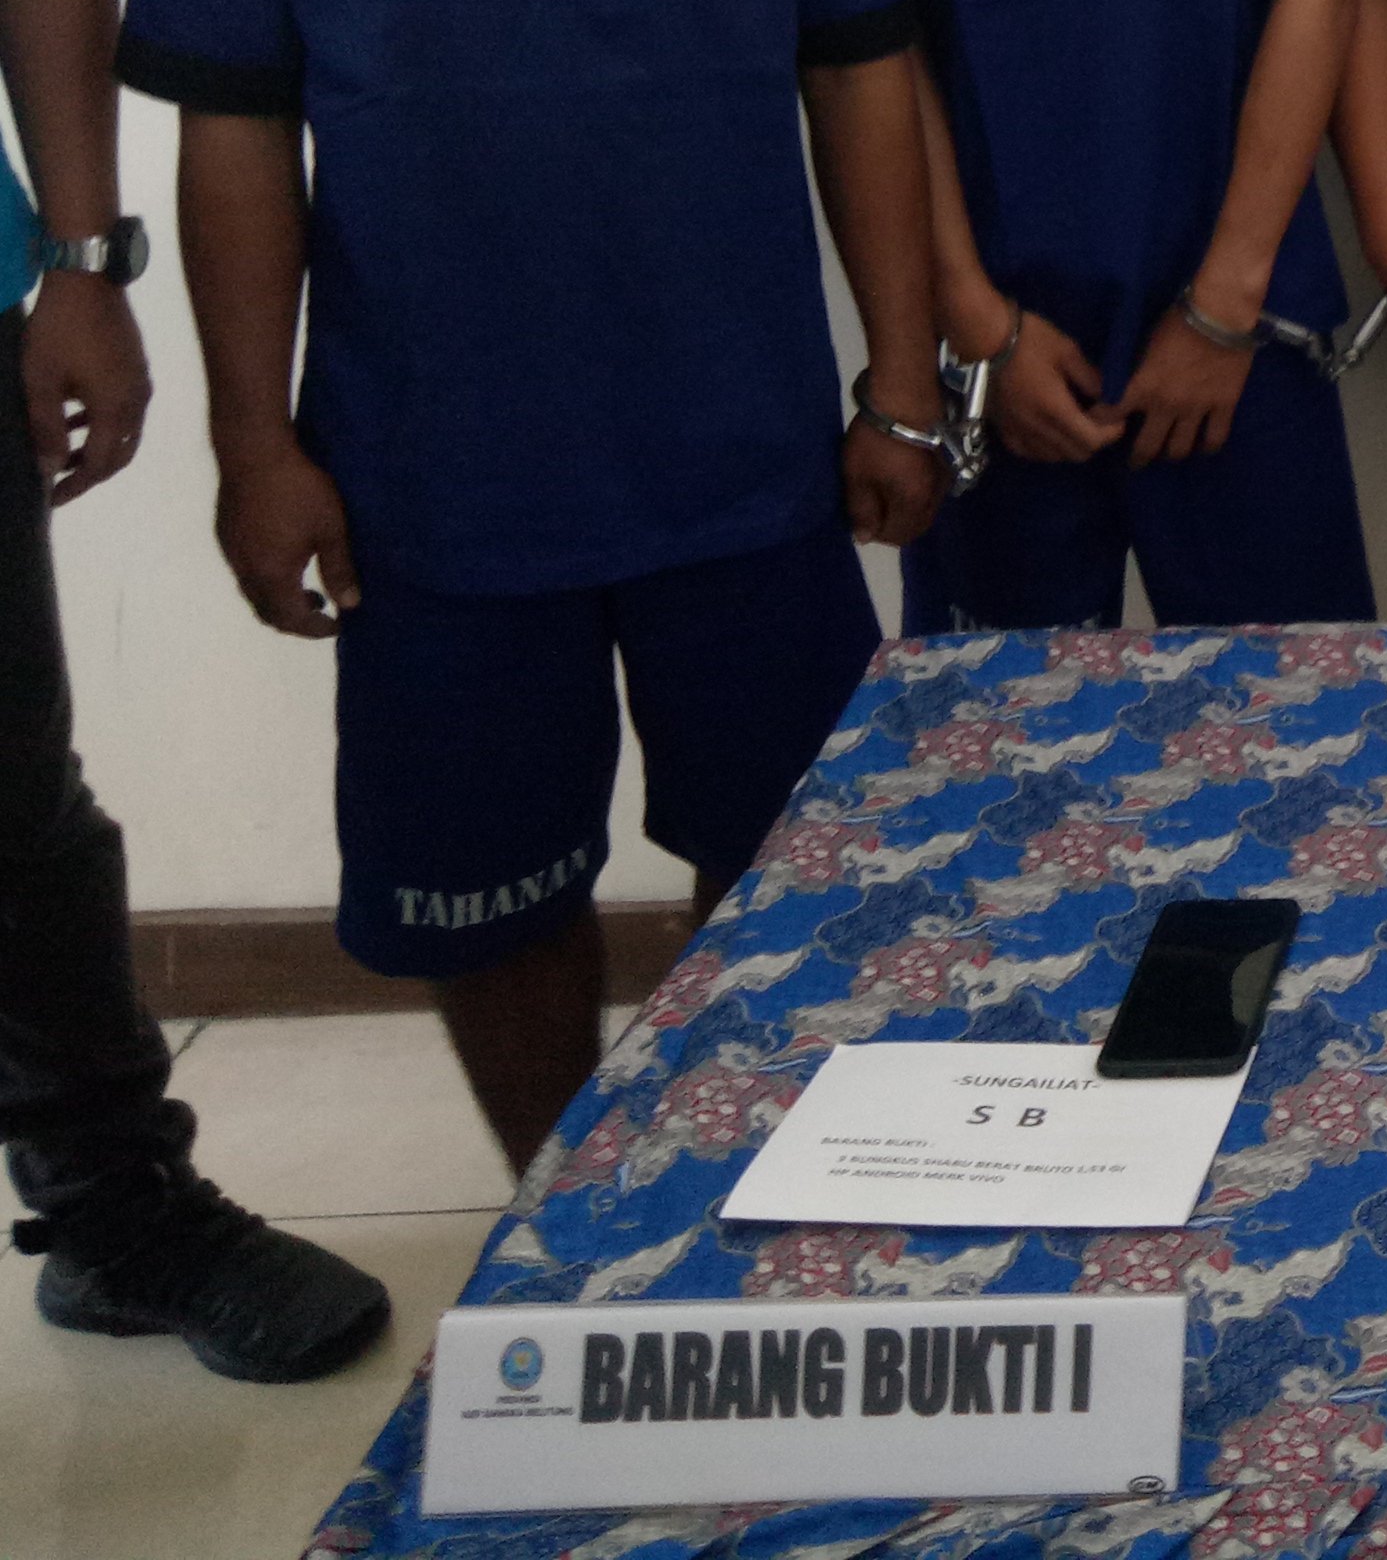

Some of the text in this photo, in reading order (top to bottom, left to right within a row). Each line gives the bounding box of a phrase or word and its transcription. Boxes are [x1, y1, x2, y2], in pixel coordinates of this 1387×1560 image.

[965, 1105, 1048, 1127] S B
[820, 1137, 882, 1147] BARANG
[579, 1323, 1093, 1423] BARANG BUKTI I
